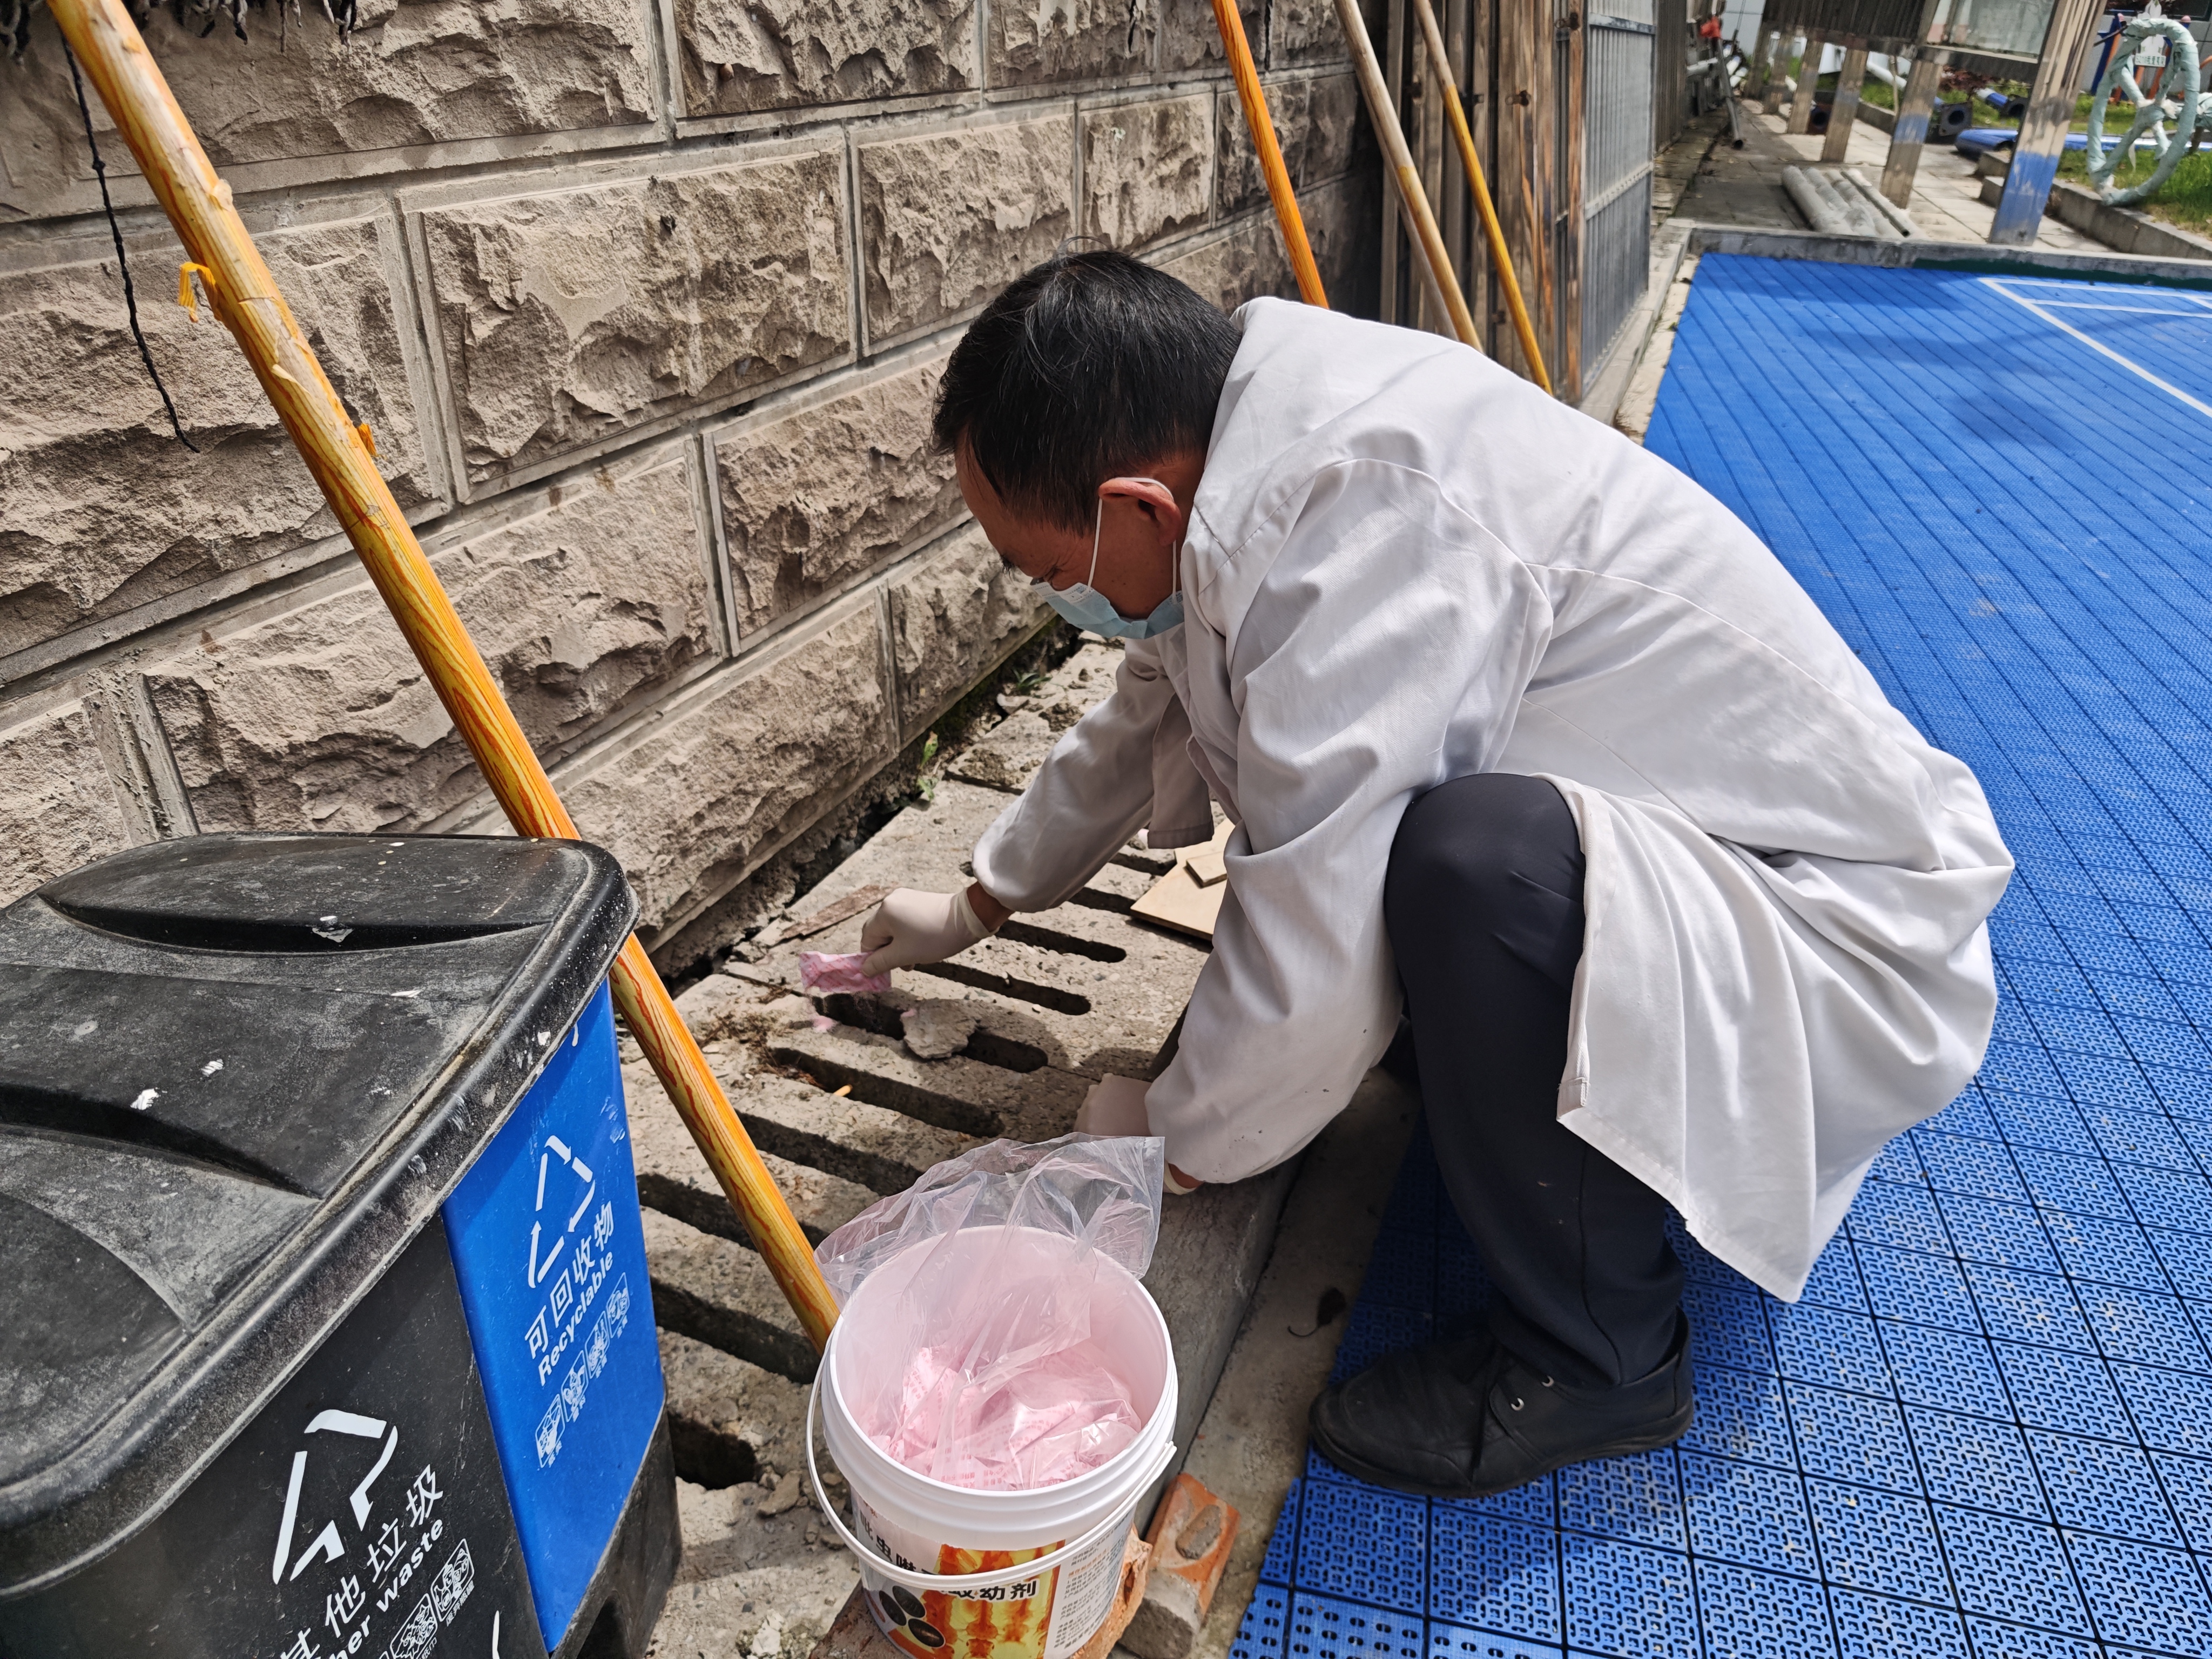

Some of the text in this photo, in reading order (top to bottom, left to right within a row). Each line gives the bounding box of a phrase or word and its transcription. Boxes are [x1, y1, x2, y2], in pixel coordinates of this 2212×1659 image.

[525, 1201, 613, 1360] 可回收物
[538, 1252, 613, 1387] Recyclable
[377, 1519, 443, 1612] waste
